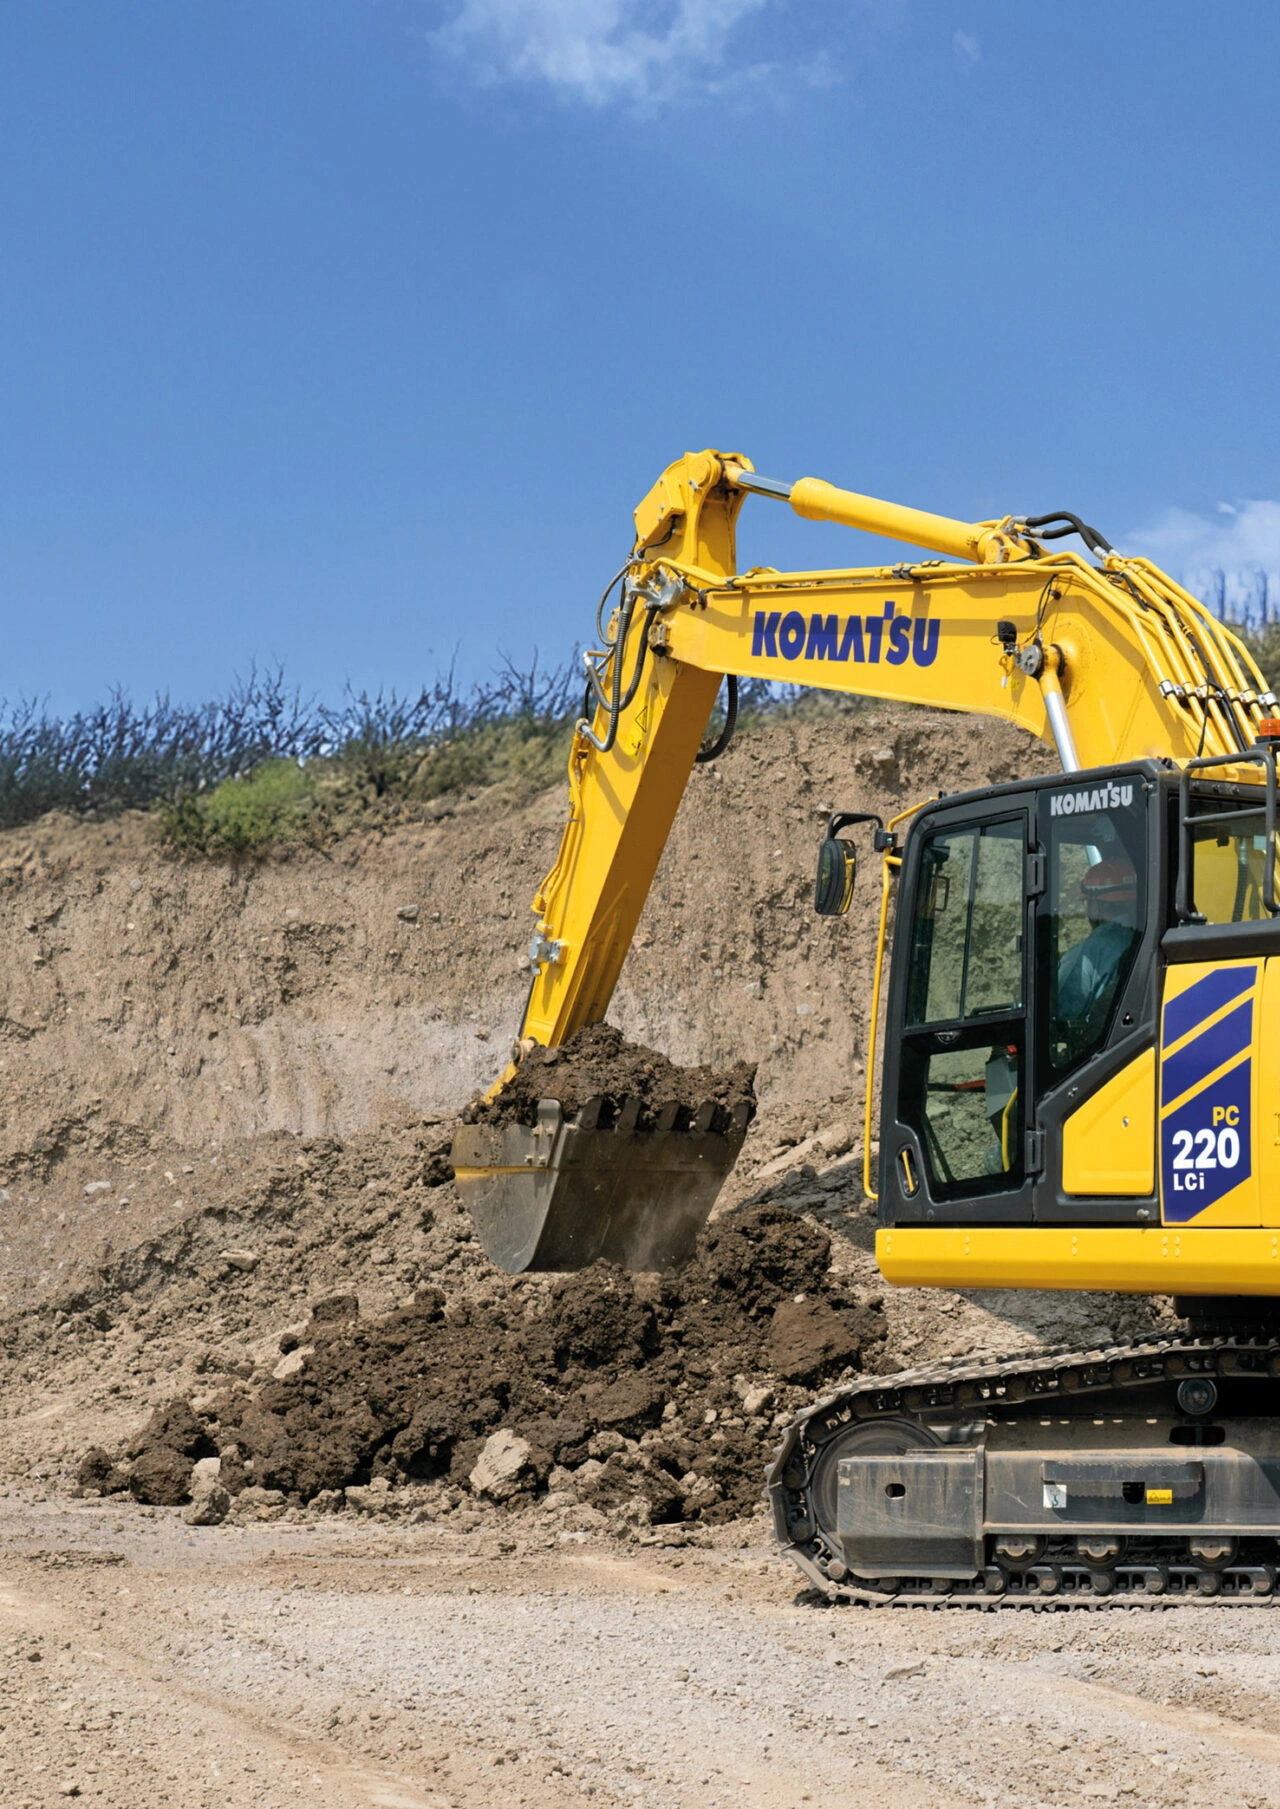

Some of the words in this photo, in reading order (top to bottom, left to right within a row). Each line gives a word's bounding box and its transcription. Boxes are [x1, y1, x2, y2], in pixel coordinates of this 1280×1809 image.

[751, 601, 941, 667] KOMATSU
[1050, 782, 1133, 816] KOMATSU
[1212, 1105, 1240, 1127] PC
[1172, 1127, 1240, 1170] 220
[1173, 1172, 1205, 1191] LCi
